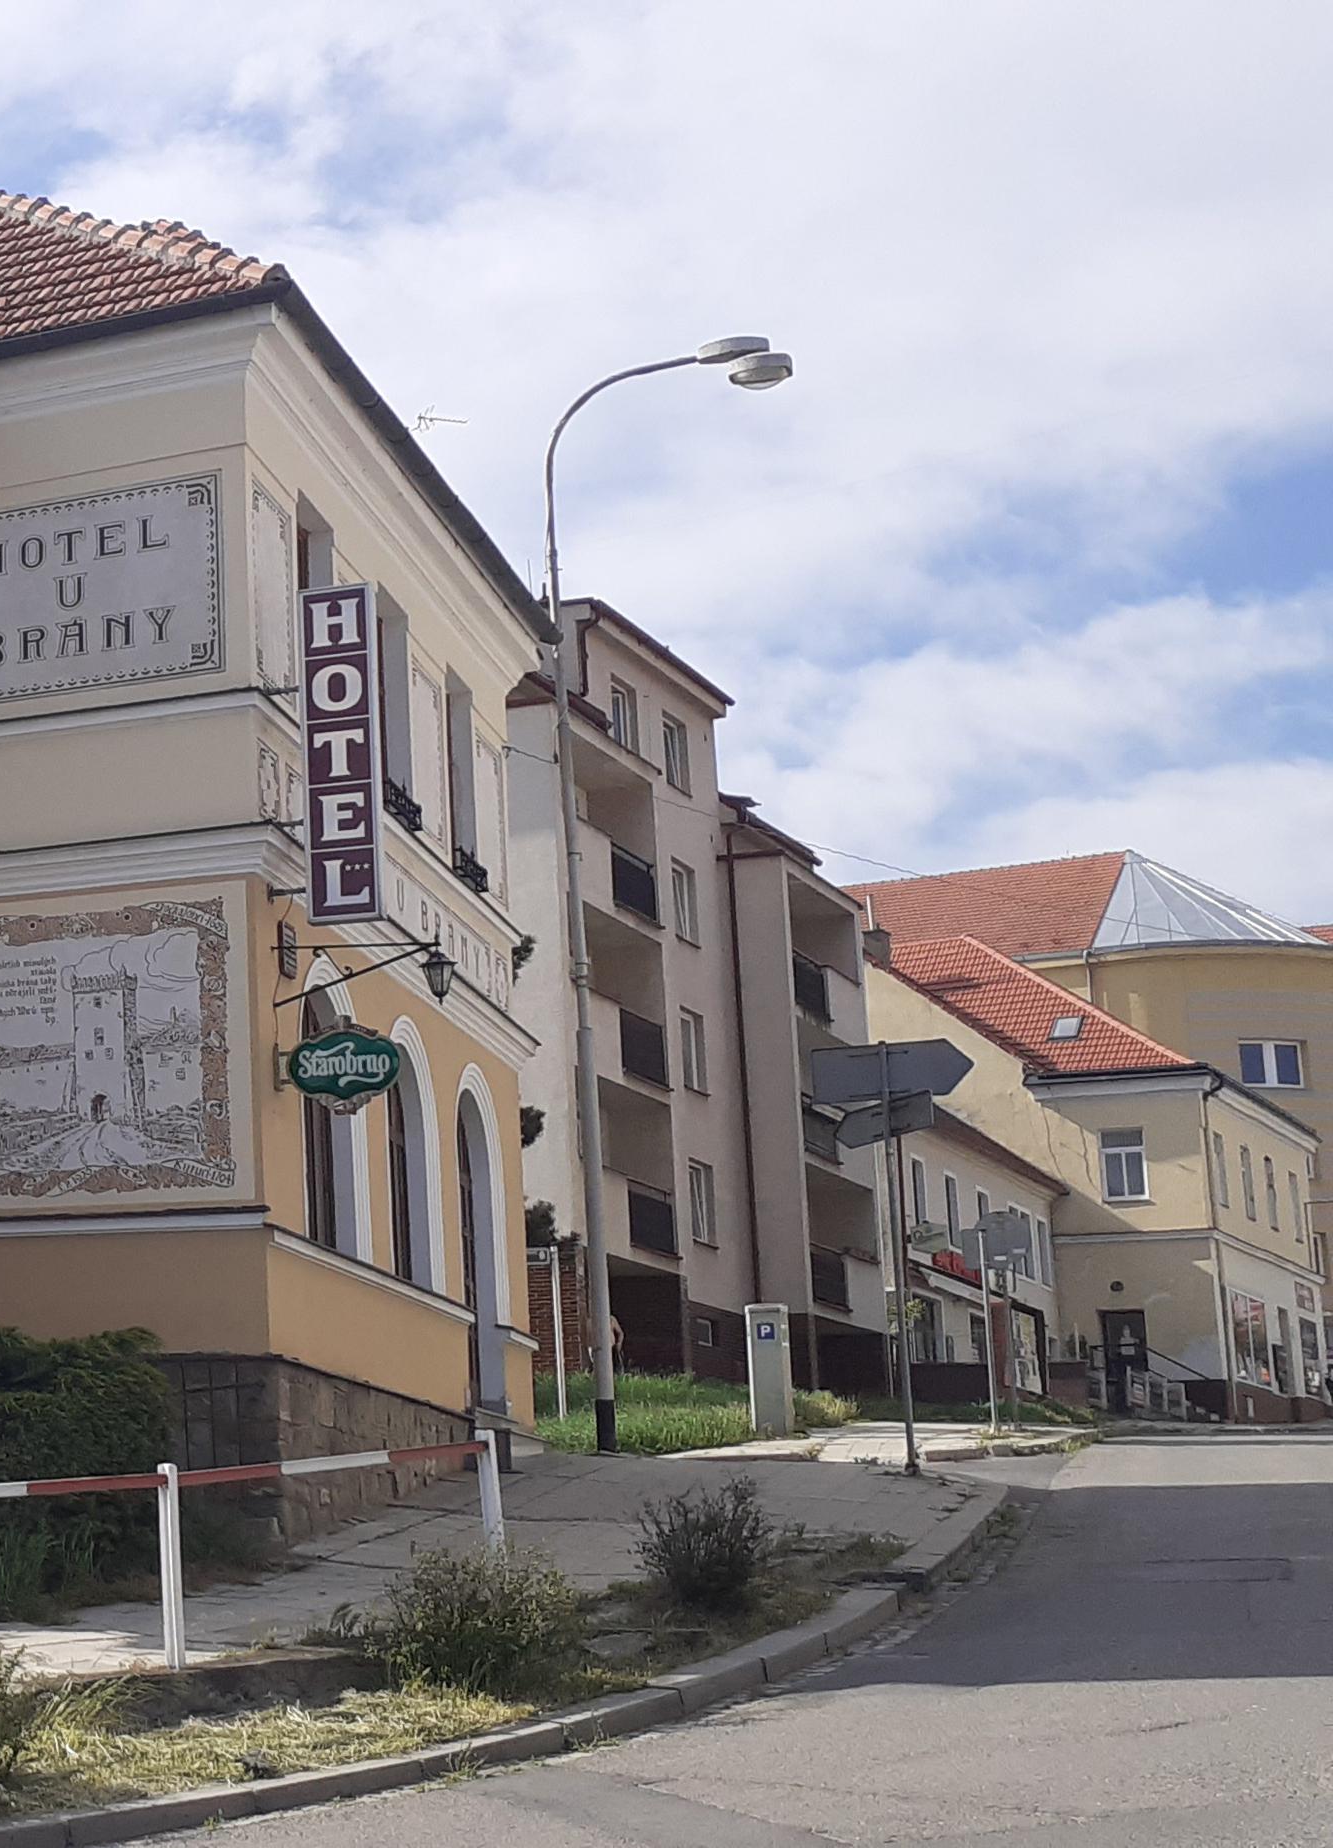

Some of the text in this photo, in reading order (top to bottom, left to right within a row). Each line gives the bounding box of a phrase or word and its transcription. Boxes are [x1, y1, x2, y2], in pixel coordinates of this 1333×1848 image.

[53, 573, 88, 610] U
[308, 597, 371, 907] HOTEL
[298, 1042, 390, 1087] Starobrno
[760, 1325, 771, 1337] P
